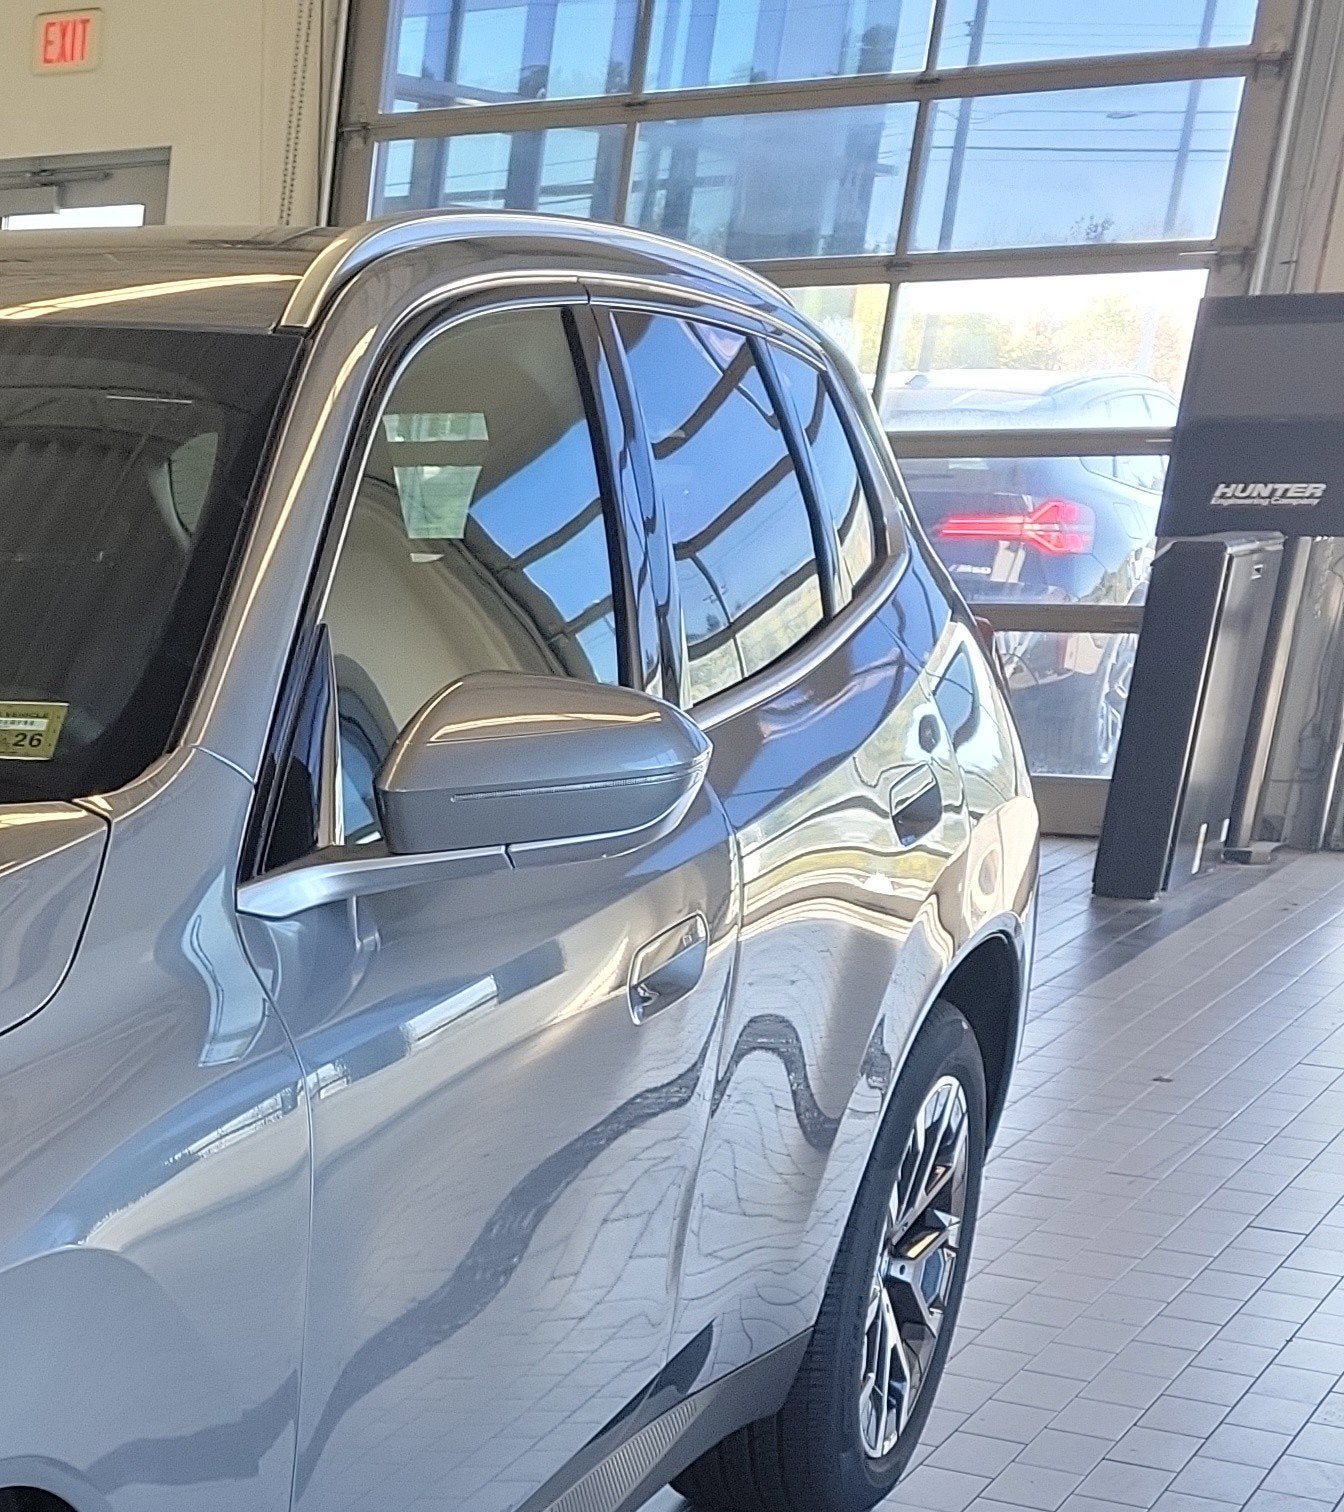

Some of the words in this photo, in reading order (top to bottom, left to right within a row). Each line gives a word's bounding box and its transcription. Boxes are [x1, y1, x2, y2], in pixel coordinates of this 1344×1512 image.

[42, 18, 91, 65] EXIT
[1213, 482, 1327, 498] HUNTER
[13, 733, 43, 748] 26
